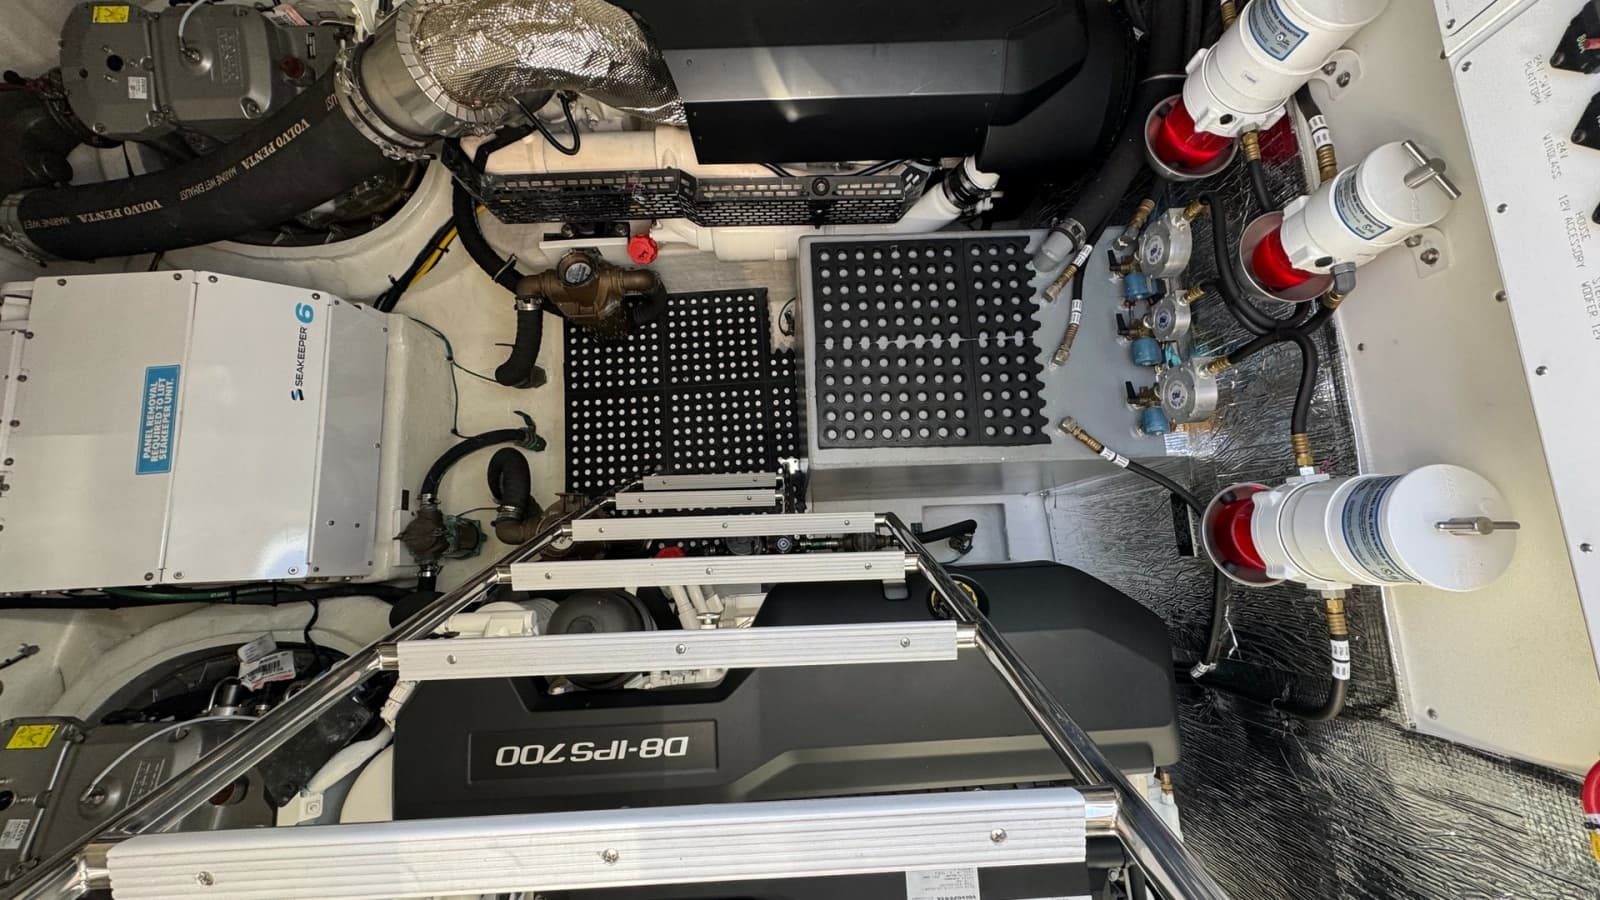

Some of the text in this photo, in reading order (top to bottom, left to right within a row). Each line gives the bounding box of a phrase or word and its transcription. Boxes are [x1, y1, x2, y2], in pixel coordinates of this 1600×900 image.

[1524, 60, 1541, 105] PLATFORM
[275, 117, 310, 149] VOLVO
[1557, 140, 1568, 159] 24V
[241, 142, 276, 170] PENTA
[1543, 132, 1562, 180] WINDLASS
[123, 198, 162, 216] VOLVO
[179, 183, 205, 201] EXHAUST
[77, 207, 122, 225] PENTA
[1558, 193, 1586, 268] 12V ACCESSORY
[1575, 210, 1591, 241] HOUSE
[1582, 281, 1598, 318] WOOFER
[294, 302, 314, 387] SEAKEEPER 6
[143, 381, 158, 459] PANEL REMOVAL
[150, 377, 166, 462] REQUIRED TO LIFT
[159, 378, 175, 460] SEAKEEPER UNIT.
